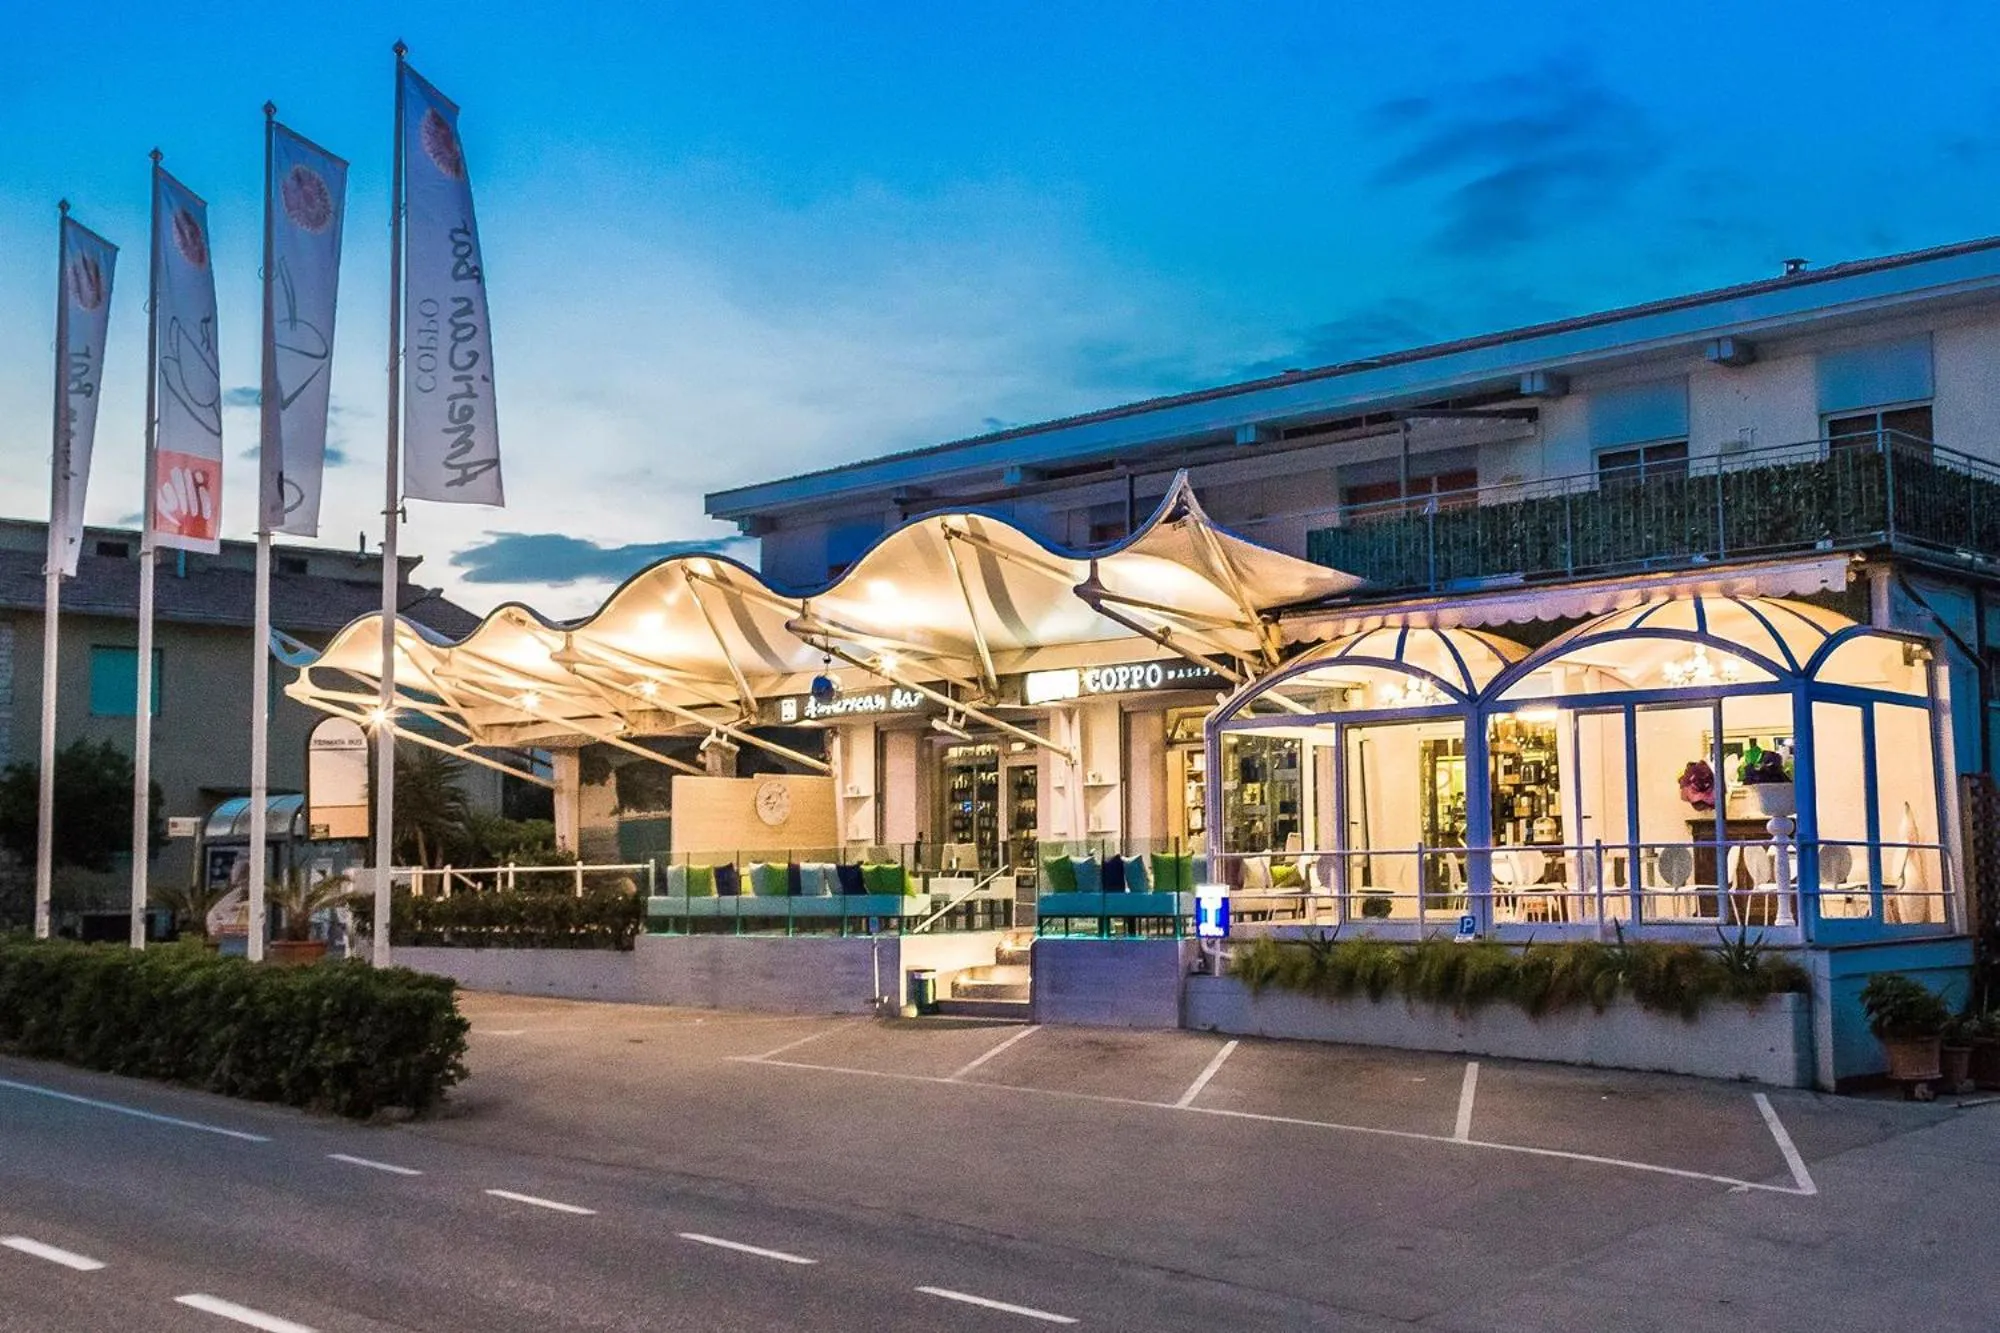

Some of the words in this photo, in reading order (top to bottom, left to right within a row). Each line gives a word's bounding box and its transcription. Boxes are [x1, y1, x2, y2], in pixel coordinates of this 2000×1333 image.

[1084, 663, 1163, 692] COPPO
[890, 688, 924, 709] Bar
[1463, 918, 1474, 932] P
